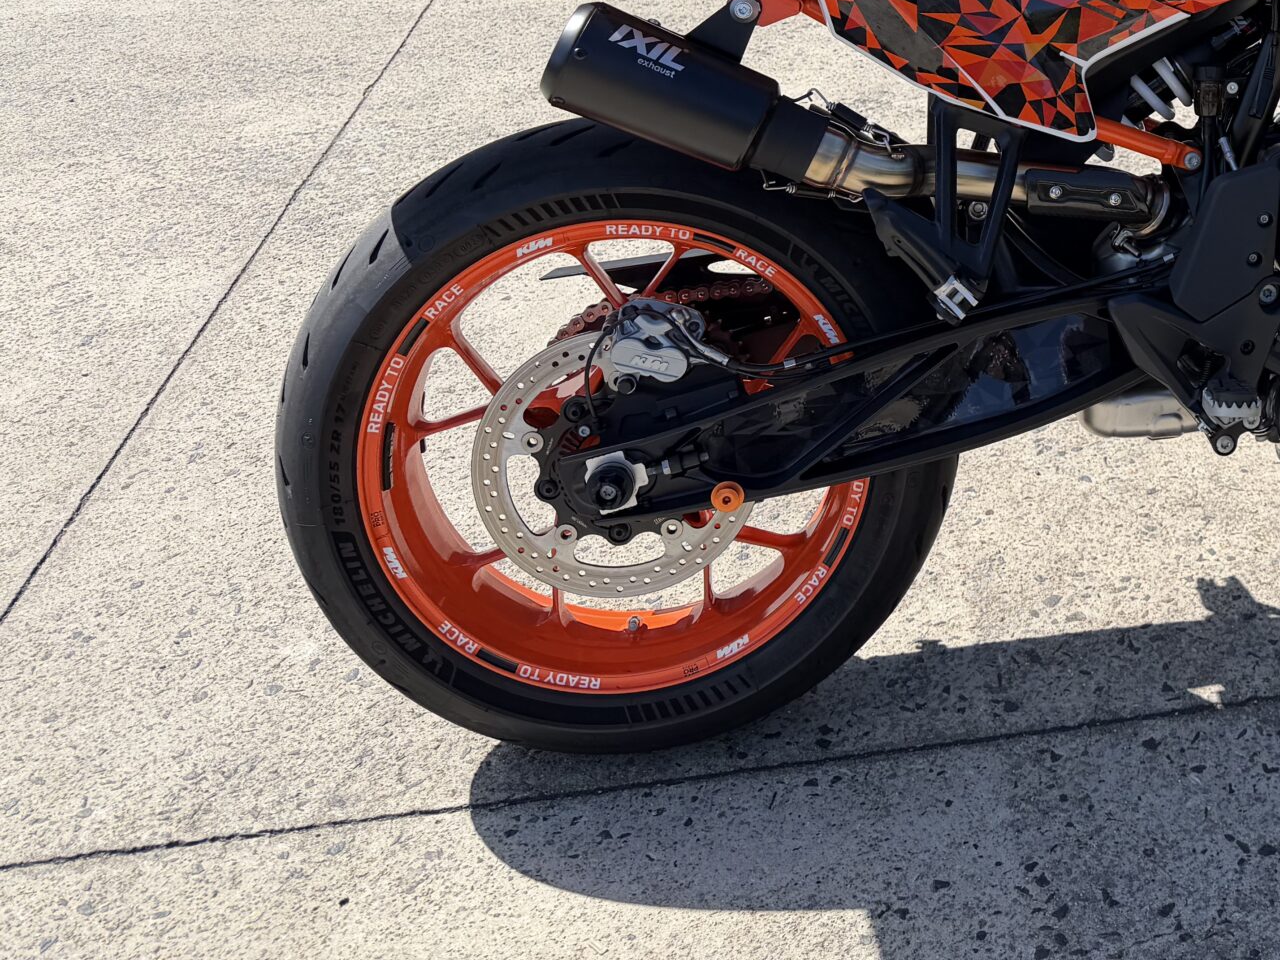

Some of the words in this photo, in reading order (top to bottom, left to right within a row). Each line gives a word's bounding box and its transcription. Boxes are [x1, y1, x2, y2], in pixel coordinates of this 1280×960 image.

[608, 24, 686, 72] IXIL
[637, 58, 676, 79] exhaust
[516, 237, 553, 258] KTM
[605, 224, 664, 235] READY
[668, 227, 691, 240] TO
[735, 248, 778, 278] RACE
[367, 381, 393, 433] READY
[387, 357, 404, 378] TO
[424, 283, 464, 320] RACE
[843, 506, 858, 526] TO
[336, 540, 421, 653] MICHELIN
[794, 566, 828, 605] RACE
[438, 620, 479, 654] RACE
[519, 665, 540, 681] TO
[544, 673, 601, 689] READY
